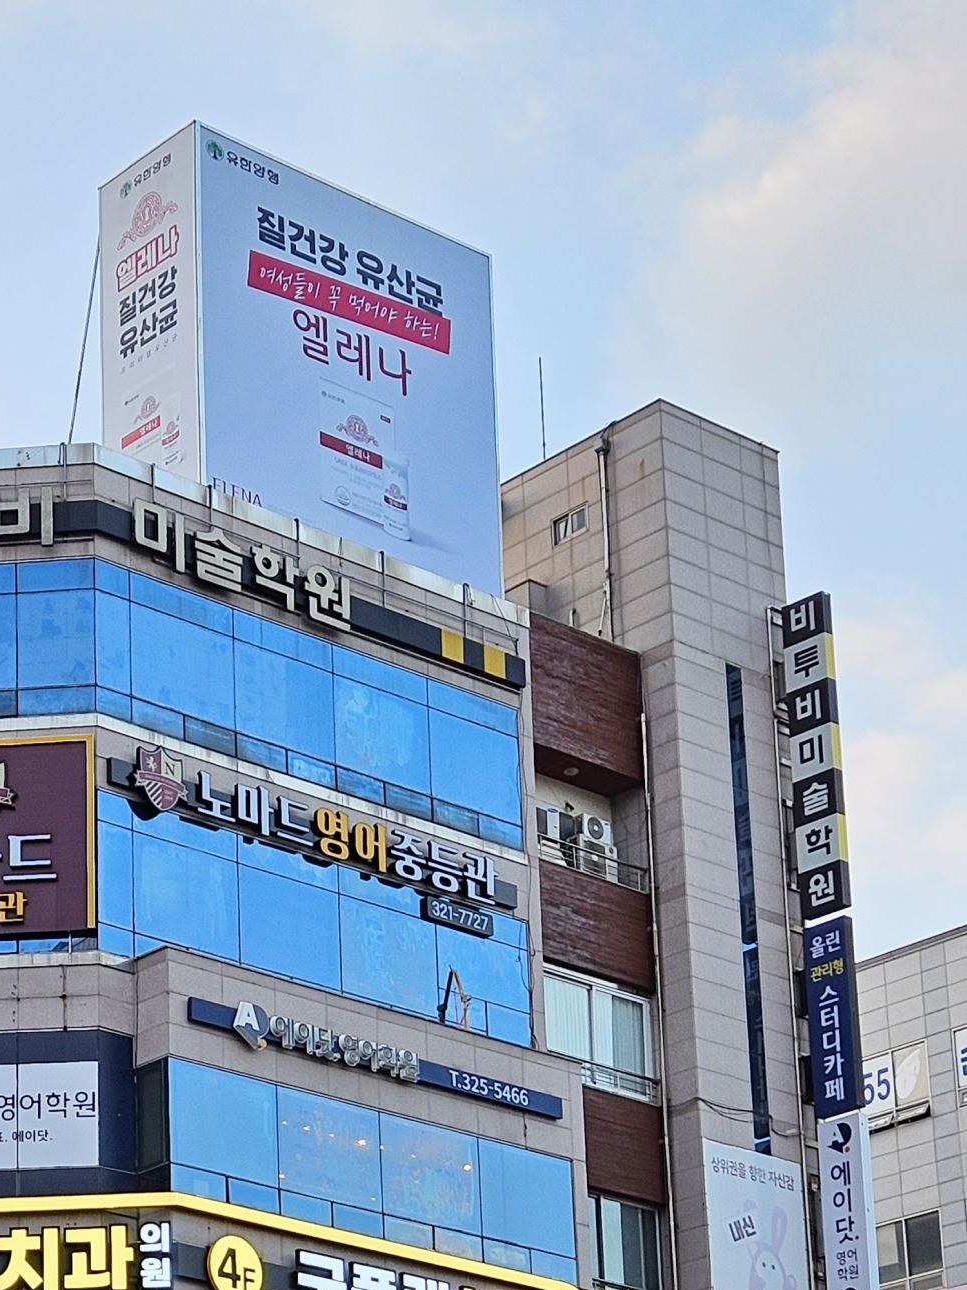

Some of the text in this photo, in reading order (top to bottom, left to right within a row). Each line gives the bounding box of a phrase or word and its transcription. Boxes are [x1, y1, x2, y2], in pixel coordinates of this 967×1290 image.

[134, 153, 171, 187] 유한양행
[226, 151, 279, 185] 유한양행
[116, 225, 179, 290] 엘레나
[257, 206, 443, 317] 질건강 유산균
[119, 265, 178, 325] 질건강
[260, 267, 440, 340] 여성들이 꼭 먹어야 하는!
[120, 302, 178, 358] 유산균
[293, 308, 412, 397] 엘레나
[345, 444, 371, 462] 엘레나
[134, 503, 354, 633] 미술학원
[790, 600, 835, 907] 비투비미술학원
[431, 900, 489, 932] 321-7727
[809, 930, 841, 959] 올린
[810, 957, 844, 983] 관리형
[818, 984, 846, 1102] 스터디카페
[449, 1069, 530, 1107] T.325-5466
[11, 1129, 53, 1144] 에이닷.
[711, 1156, 795, 1192] 상위권을 향한 자신감
[729, 1215, 757, 1243] 내신
[836, 1248, 858, 1266] 영어
[837, 1264, 859, 1282] 학원
